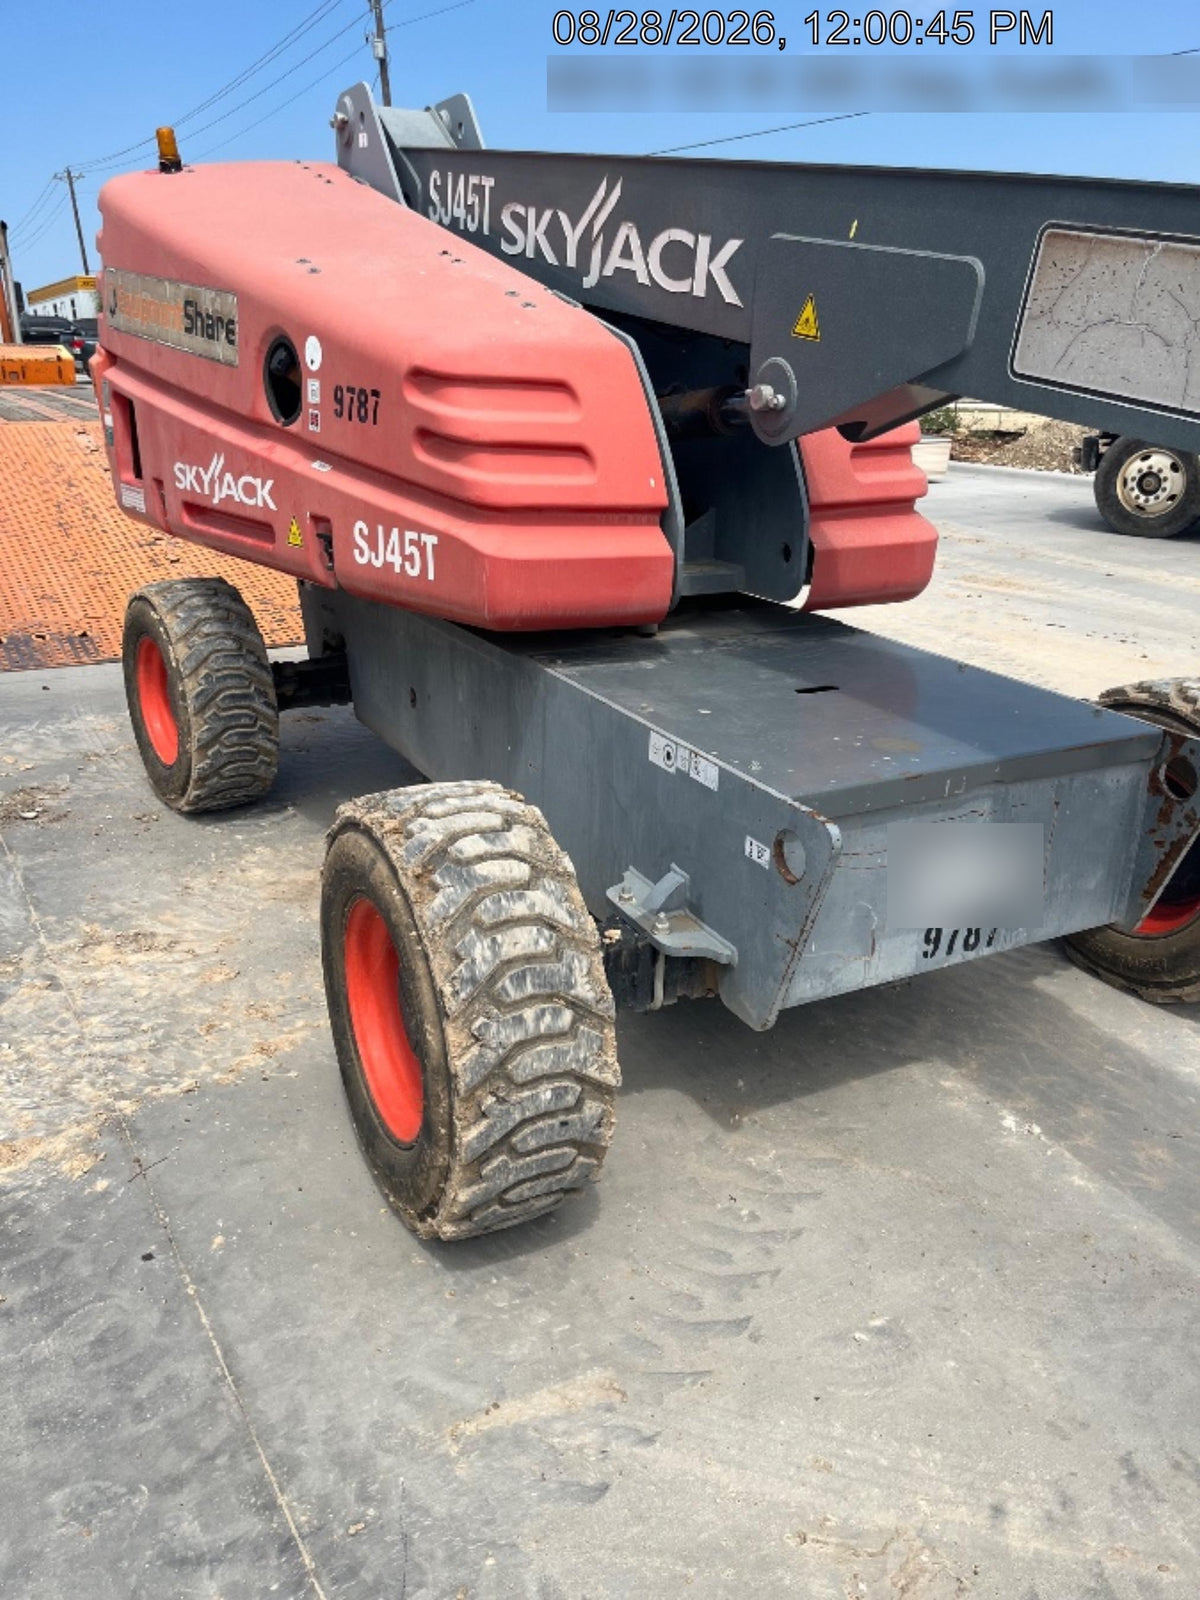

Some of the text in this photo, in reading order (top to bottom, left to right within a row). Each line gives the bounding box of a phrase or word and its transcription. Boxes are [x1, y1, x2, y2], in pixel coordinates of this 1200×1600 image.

[428, 169, 745, 309] SJ45T SKYJACK
[333, 384, 381, 426] 9787
[173, 452, 279, 511] SKYJACK
[353, 519, 439, 581] SJ45T
